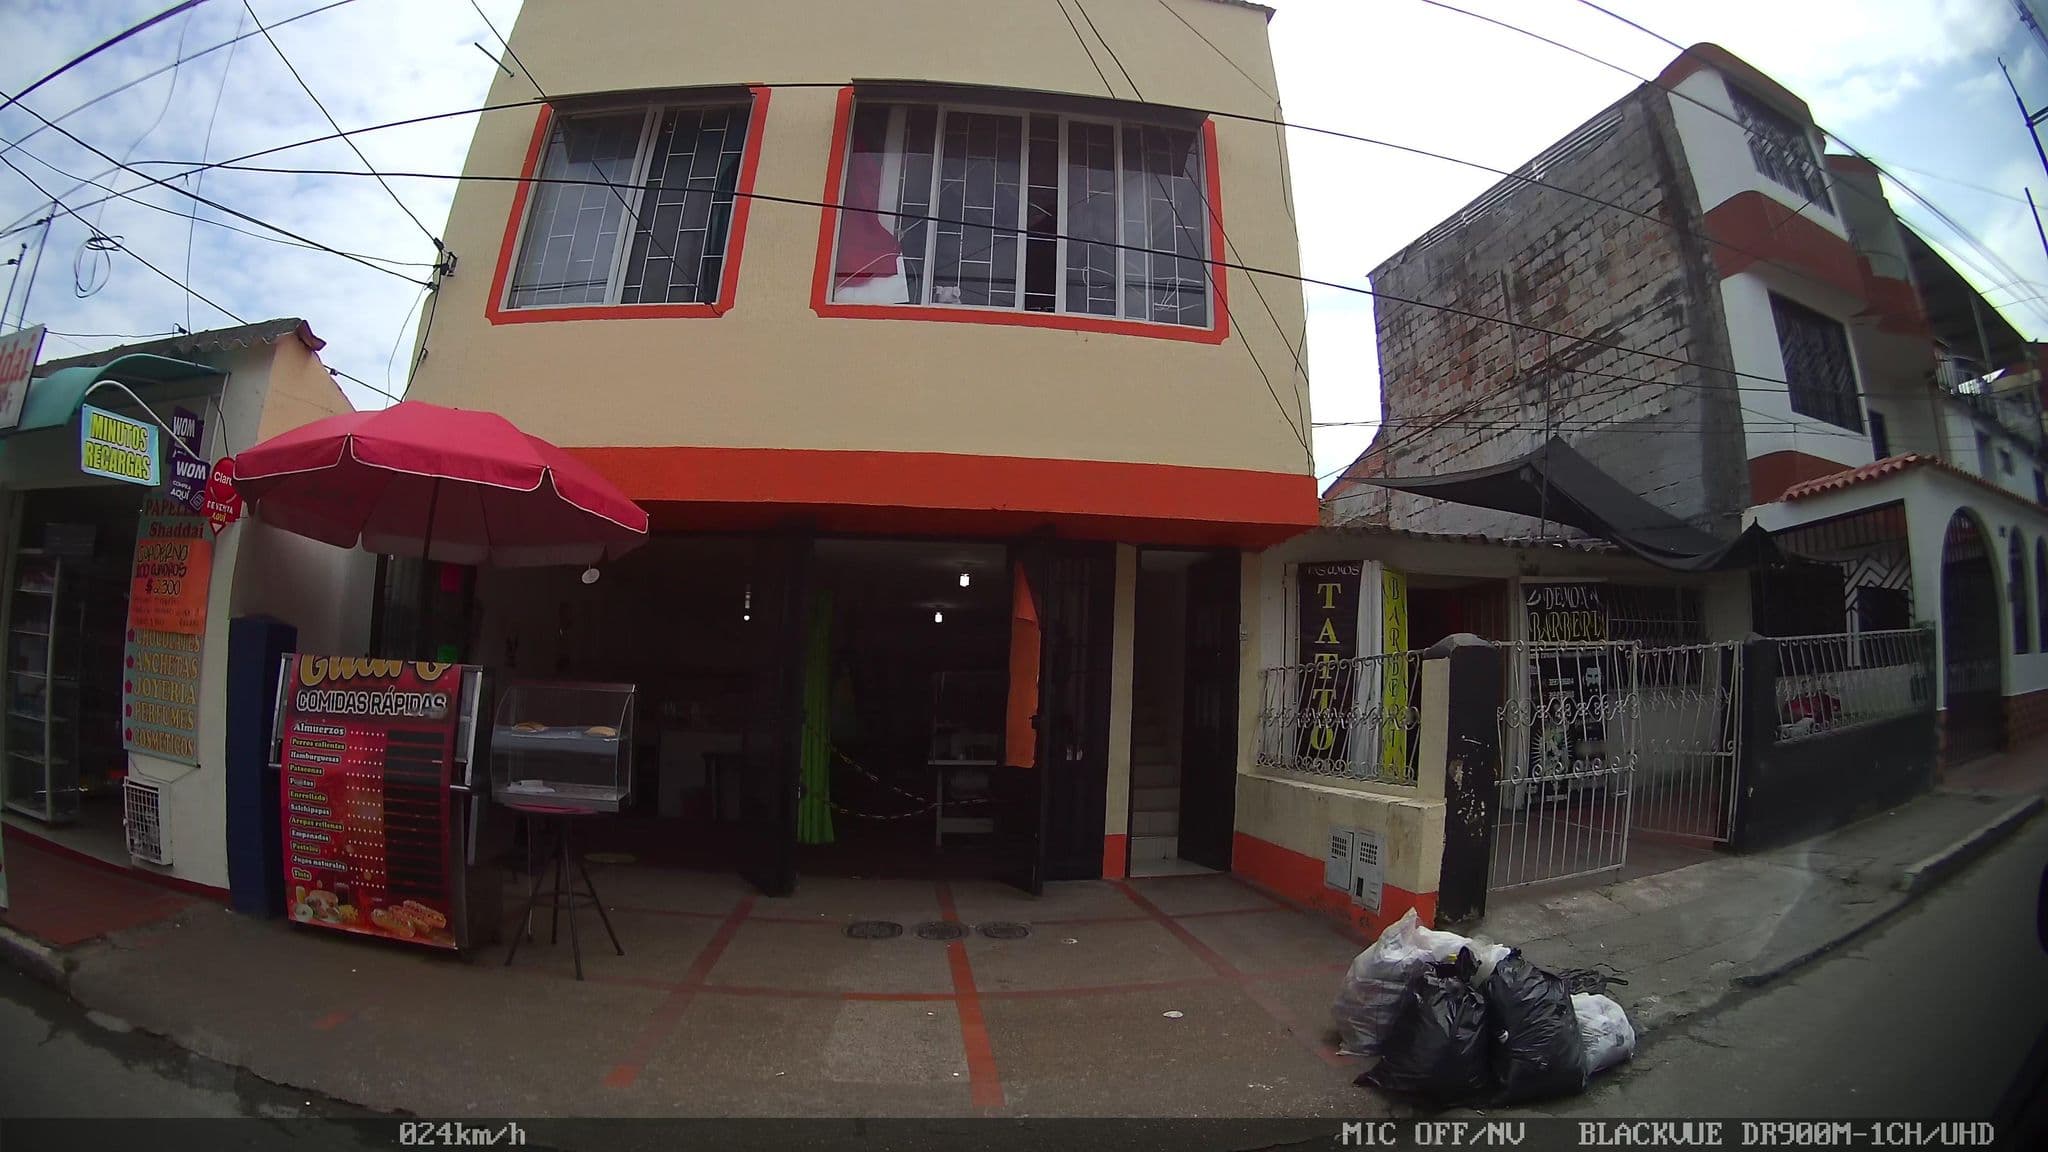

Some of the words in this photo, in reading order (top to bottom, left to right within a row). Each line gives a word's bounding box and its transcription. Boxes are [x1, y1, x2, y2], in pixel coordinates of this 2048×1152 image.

[91, 413, 149, 453] MINUTOS
[173, 416, 196, 438] WOM
[86, 440, 152, 481] RECARGAS
[176, 460, 207, 480] WOM
[149, 521, 204, 539] Shaddai
[136, 650, 199, 680] ANCHETAS
[134, 677, 197, 705] JOYERIA
[297, 690, 368, 714] COMIDAS
[369, 685, 447, 718] RÁPIDAS
[134, 701, 194, 730] PERFUMES
[293, 721, 345, 736] Almuerzos
[133, 728, 194, 758] COSMETICOS
[292, 738, 314, 747] Perros
[314, 740, 345, 750] calientes
[290, 750, 340, 763] Hamburguesas
[293, 855, 312, 865] Jugos
[313, 859, 346, 871] naturales
